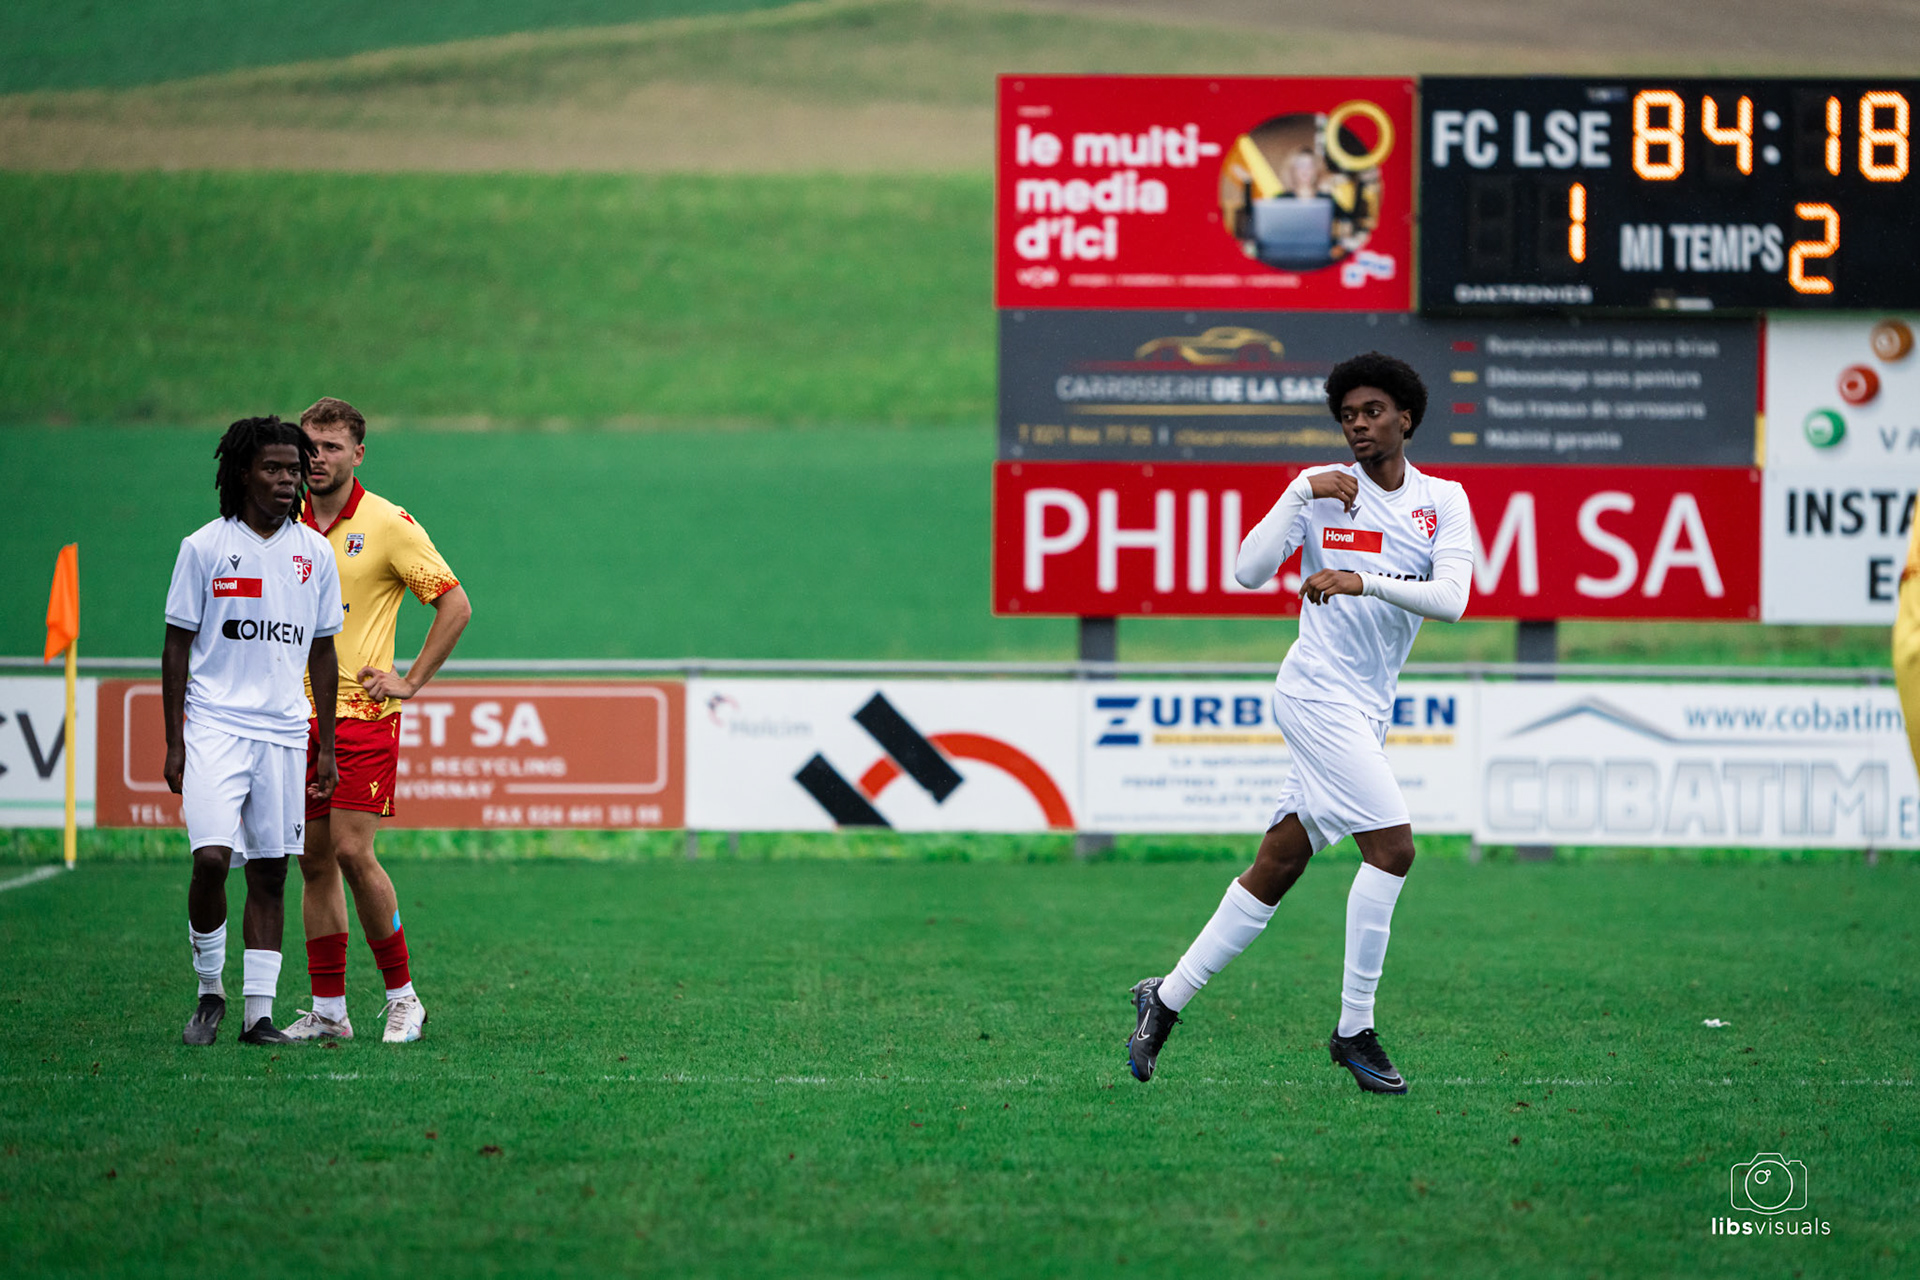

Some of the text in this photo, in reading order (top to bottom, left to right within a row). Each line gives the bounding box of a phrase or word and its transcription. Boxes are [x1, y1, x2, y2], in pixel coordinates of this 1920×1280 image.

[1016, 124, 1221, 167] le multi-
[1432, 110, 1499, 168] FC
[1514, 110, 1611, 168] LSE
[1016, 171, 1167, 213] media
[1569, 182, 1586, 263] 1
[1620, 202, 1840, 294] MI TEMPS 2
[1325, 530, 1354, 543] Hoval
[1575, 490, 1726, 599] SA
[214, 580, 238, 590] Hoval
[470, 701, 547, 748] SA
[395, 779, 494, 799] VORNAY
[431, 757, 566, 777] RECYCLING
[1486, 758, 1889, 836] COBATIM
